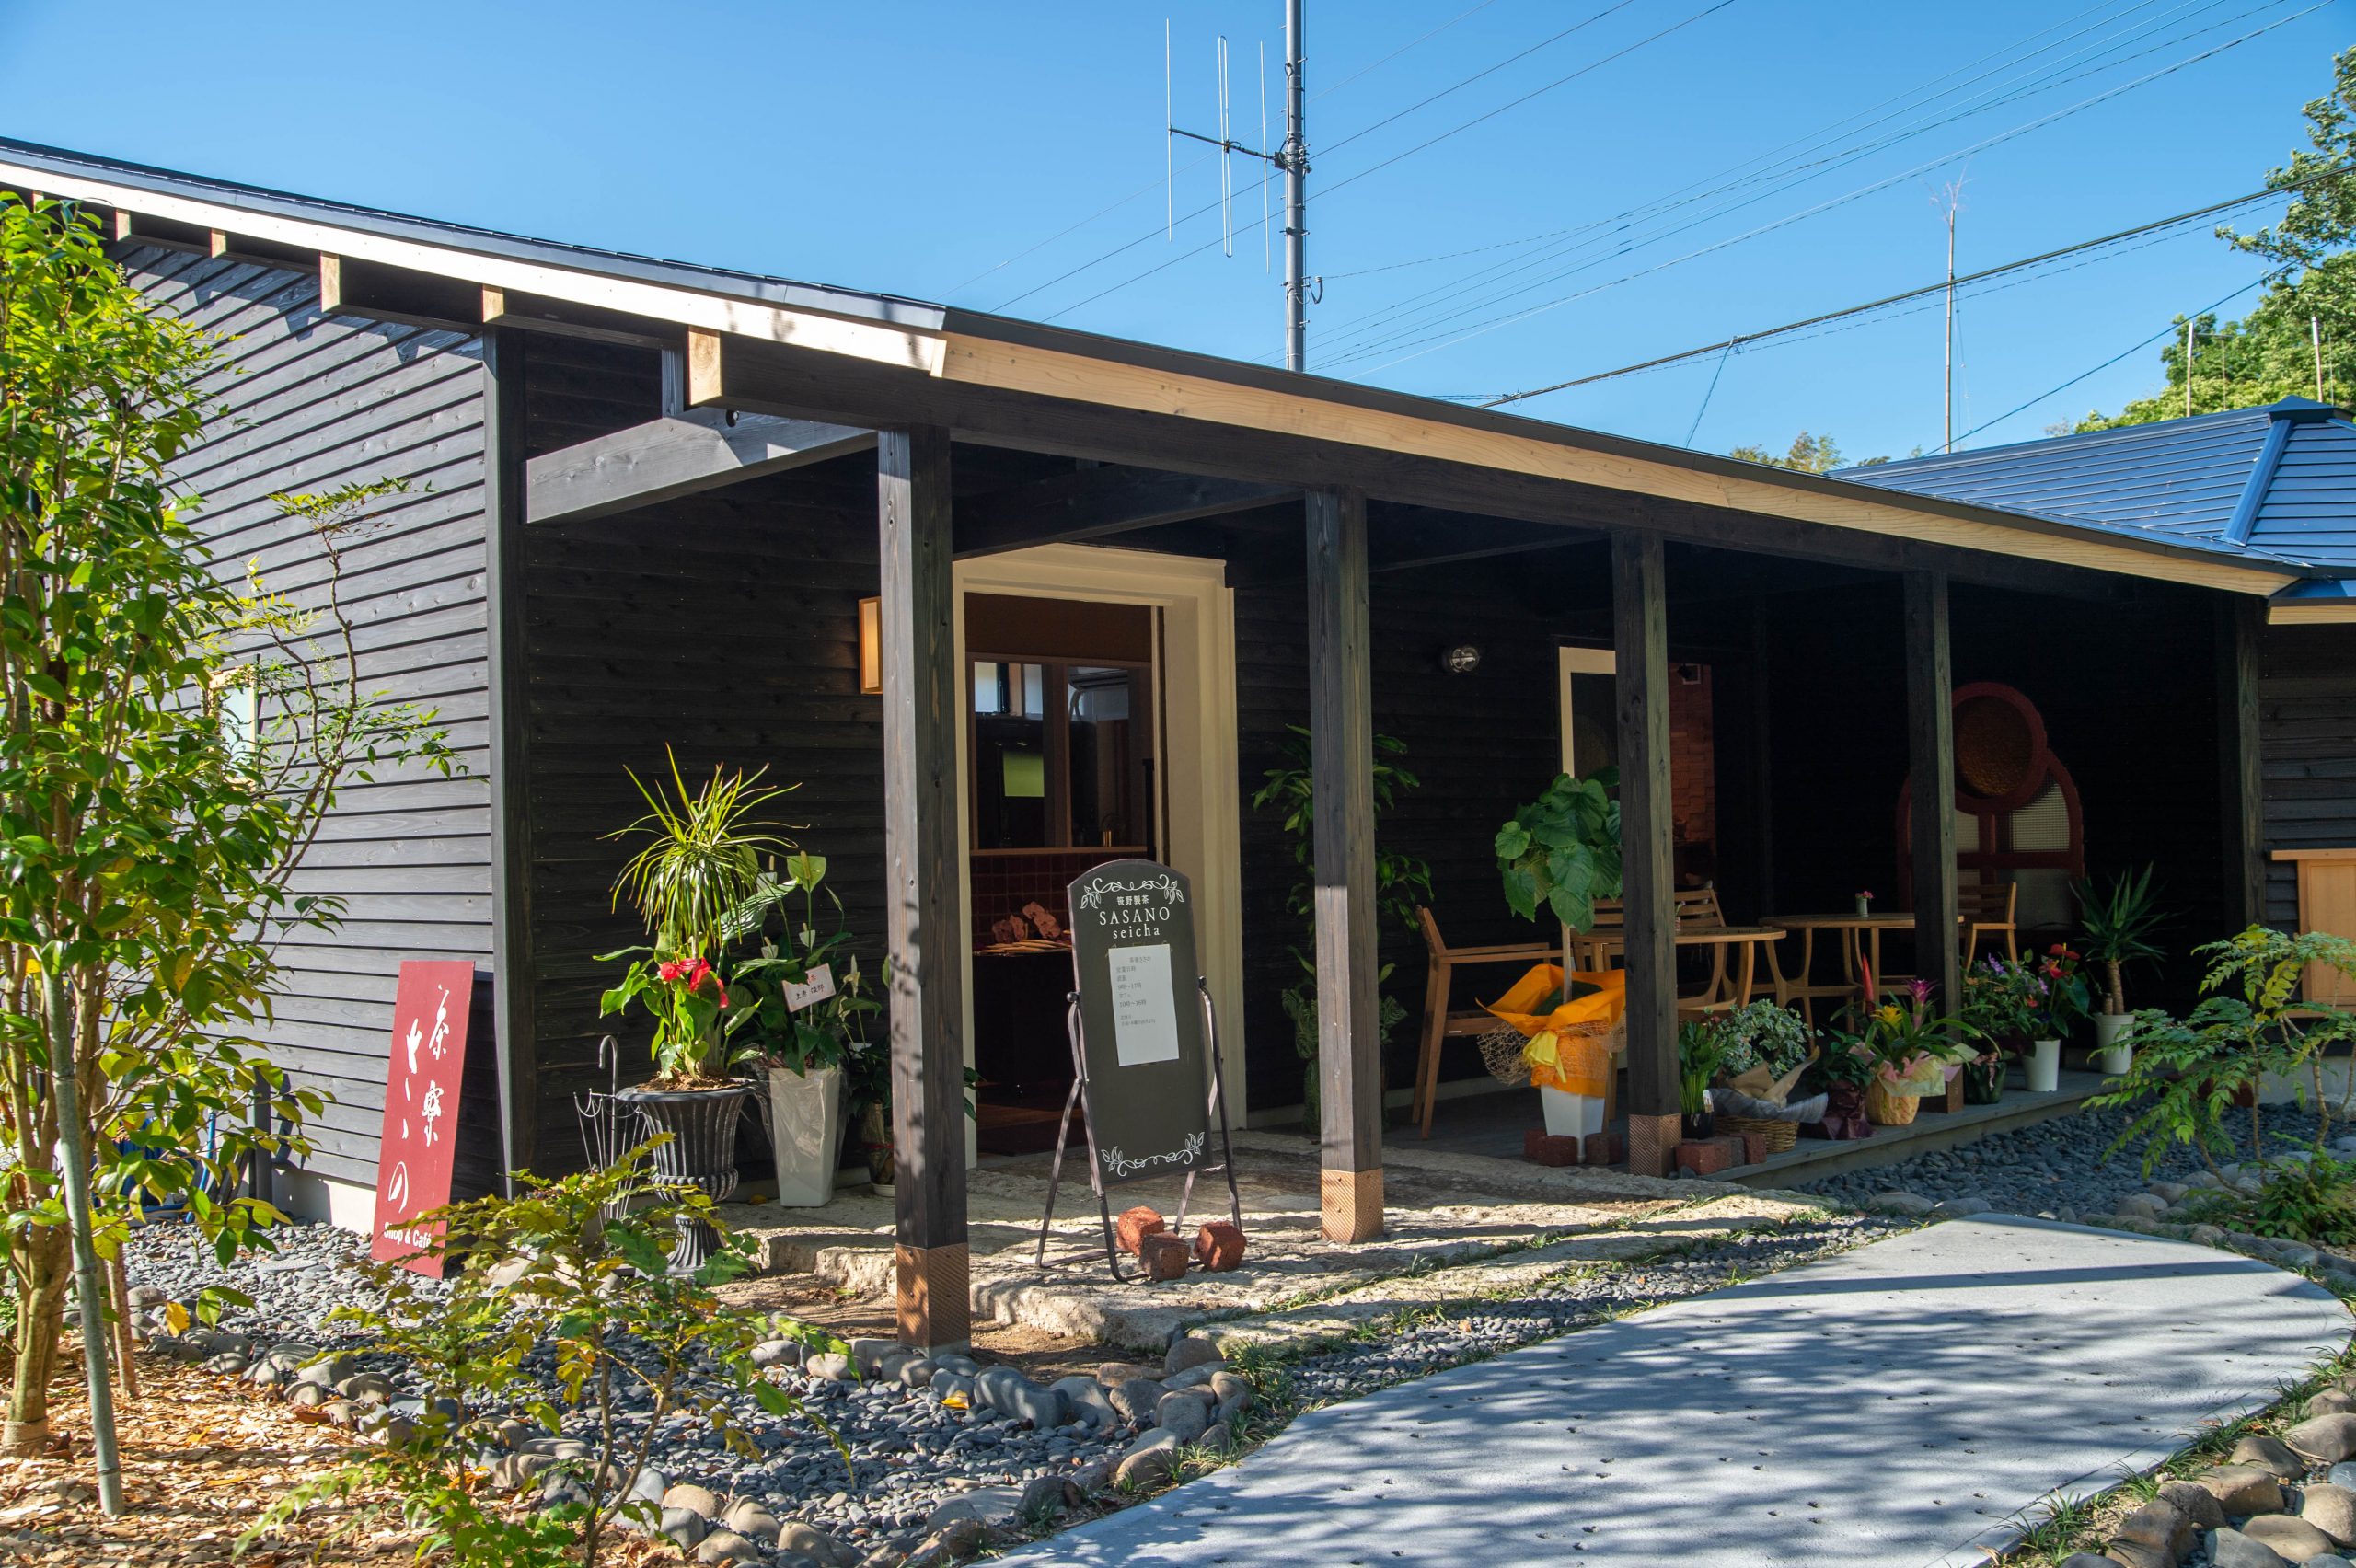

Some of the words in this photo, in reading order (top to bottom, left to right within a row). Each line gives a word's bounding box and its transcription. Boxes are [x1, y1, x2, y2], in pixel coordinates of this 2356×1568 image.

[1116, 894, 1149, 906] 笹野製茶
[1099, 906, 1171, 926] SASANO
[1113, 924, 1161, 940] seicha
[404, 1228, 411, 1244] &
[412, 1229, 432, 1249] Café
